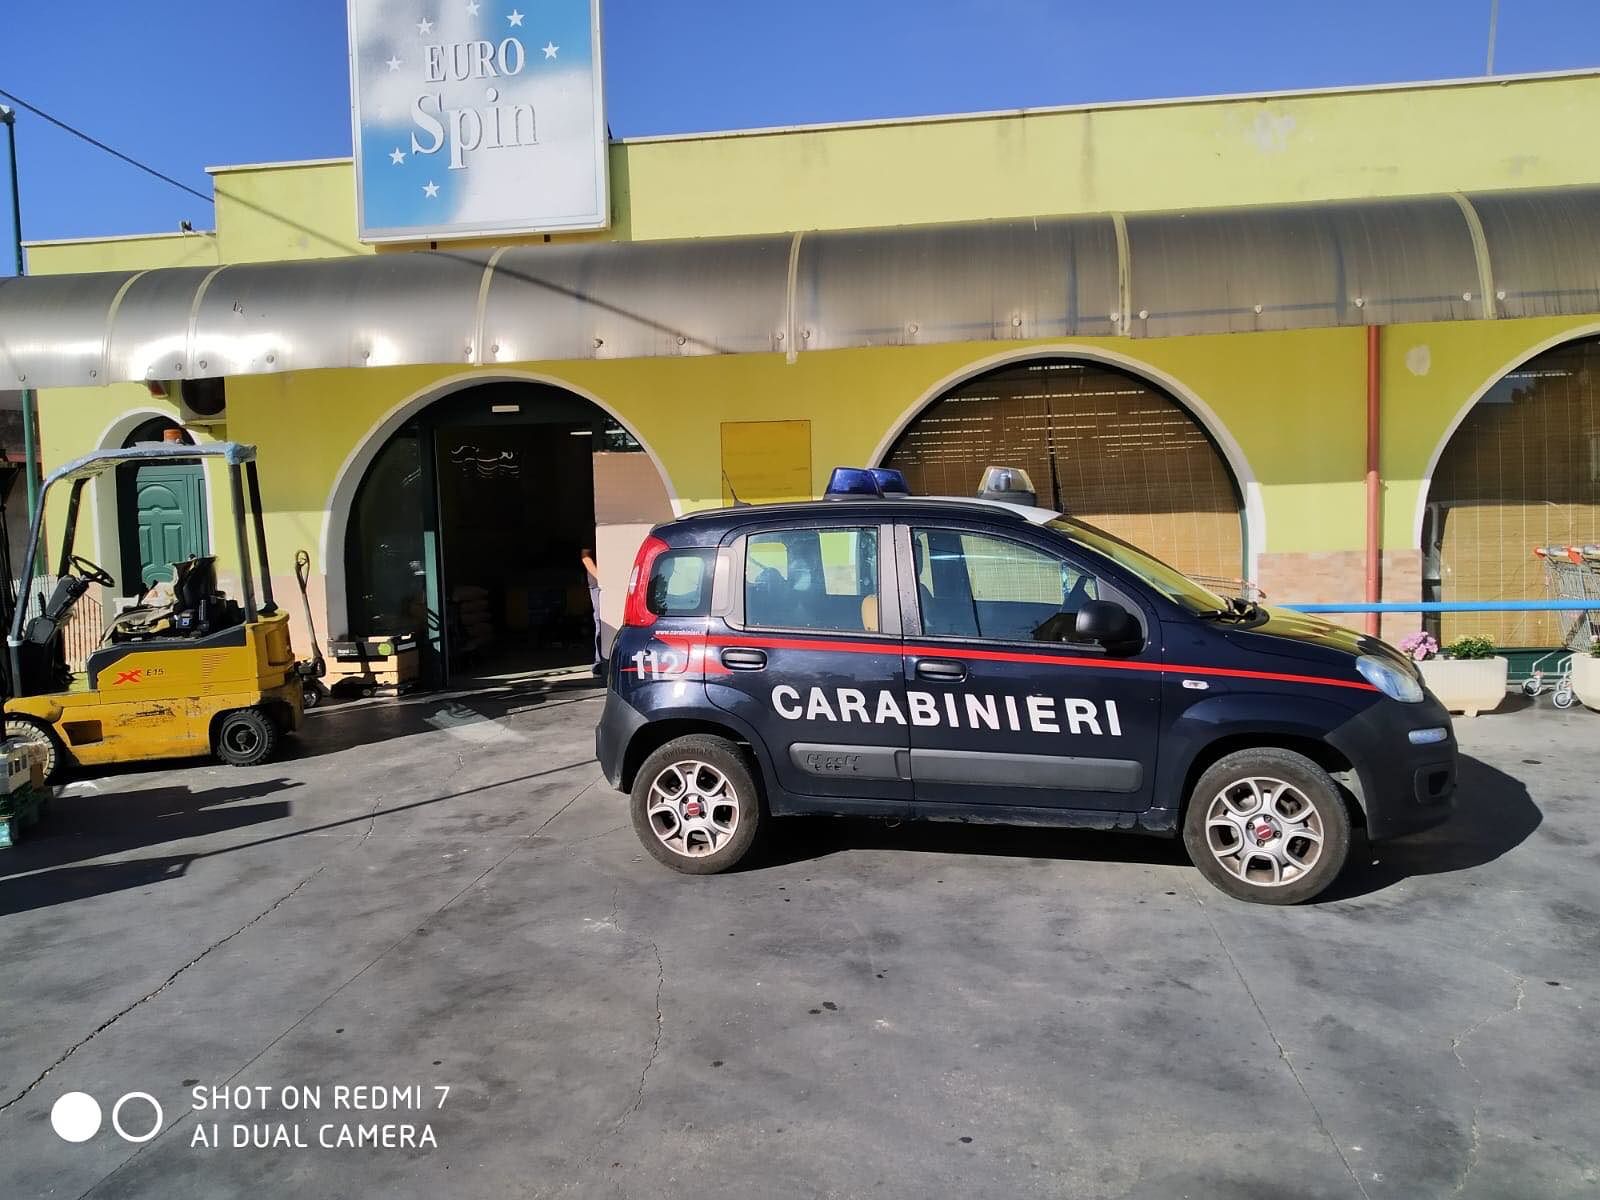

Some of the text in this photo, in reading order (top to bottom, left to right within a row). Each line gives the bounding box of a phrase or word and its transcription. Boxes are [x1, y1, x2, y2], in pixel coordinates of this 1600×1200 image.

[424, 37, 526, 83] EURO
[411, 88, 540, 170] Spin
[632, 649, 682, 681] 112
[771, 684, 1123, 737] CARABINIERI
